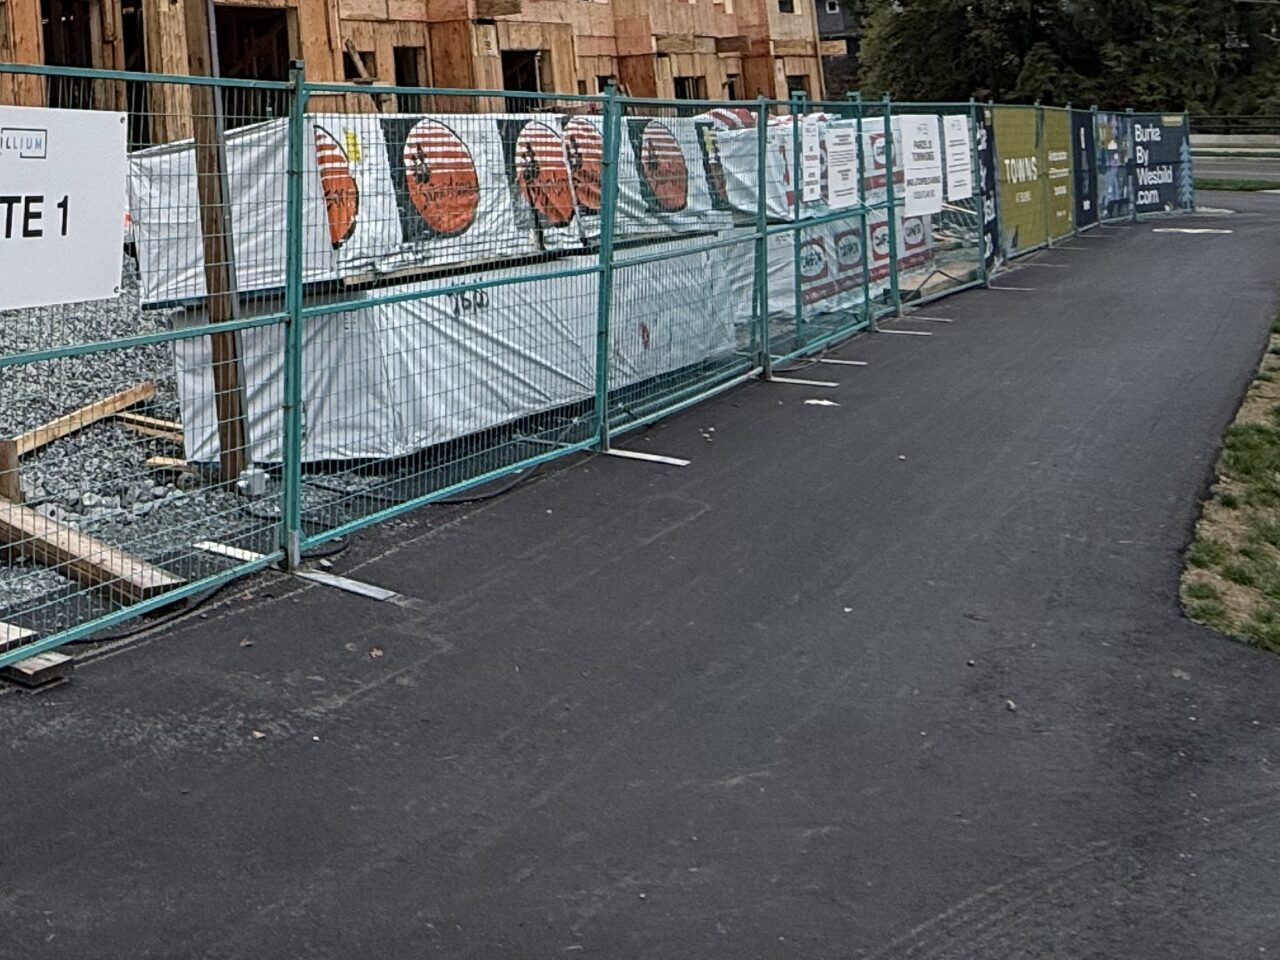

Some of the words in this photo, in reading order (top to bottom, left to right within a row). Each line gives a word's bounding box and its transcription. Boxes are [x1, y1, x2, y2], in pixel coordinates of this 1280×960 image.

[1135, 145, 1149, 167] By
[1004, 156, 1038, 185] TOWNS
[1136, 165, 1173, 186] Wesbild
[1136, 189, 1160, 205] .com
[56, 194, 69, 237] 1
